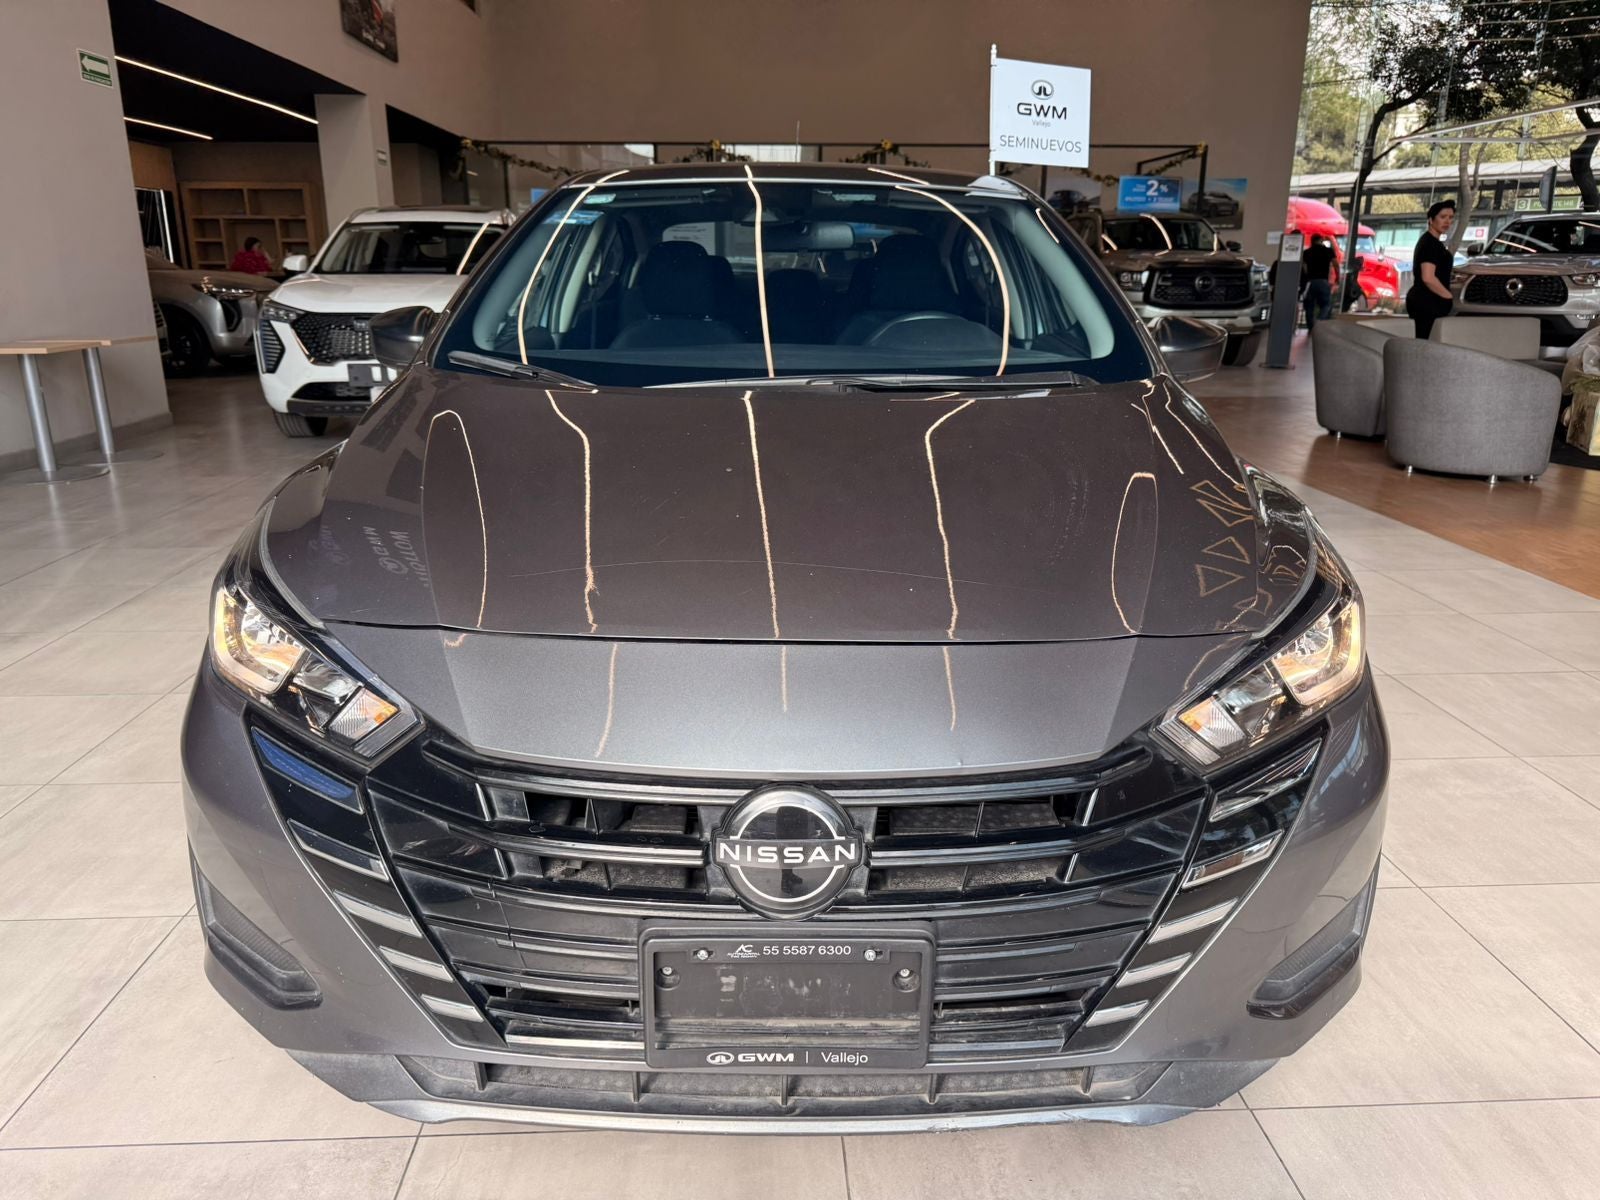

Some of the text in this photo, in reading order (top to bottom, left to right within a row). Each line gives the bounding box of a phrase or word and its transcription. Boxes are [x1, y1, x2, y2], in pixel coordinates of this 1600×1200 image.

[1016, 102, 1067, 120] GWM
[1032, 119, 1051, 128] Vallejo
[999, 134, 1082, 153] SEMINUEVOS
[1518, 199, 1526, 209] 3
[719, 841, 857, 864] NISSAN
[762, 945, 852, 955] 55 5587 6300
[737, 1051, 869, 1065] GWM Vallejo
